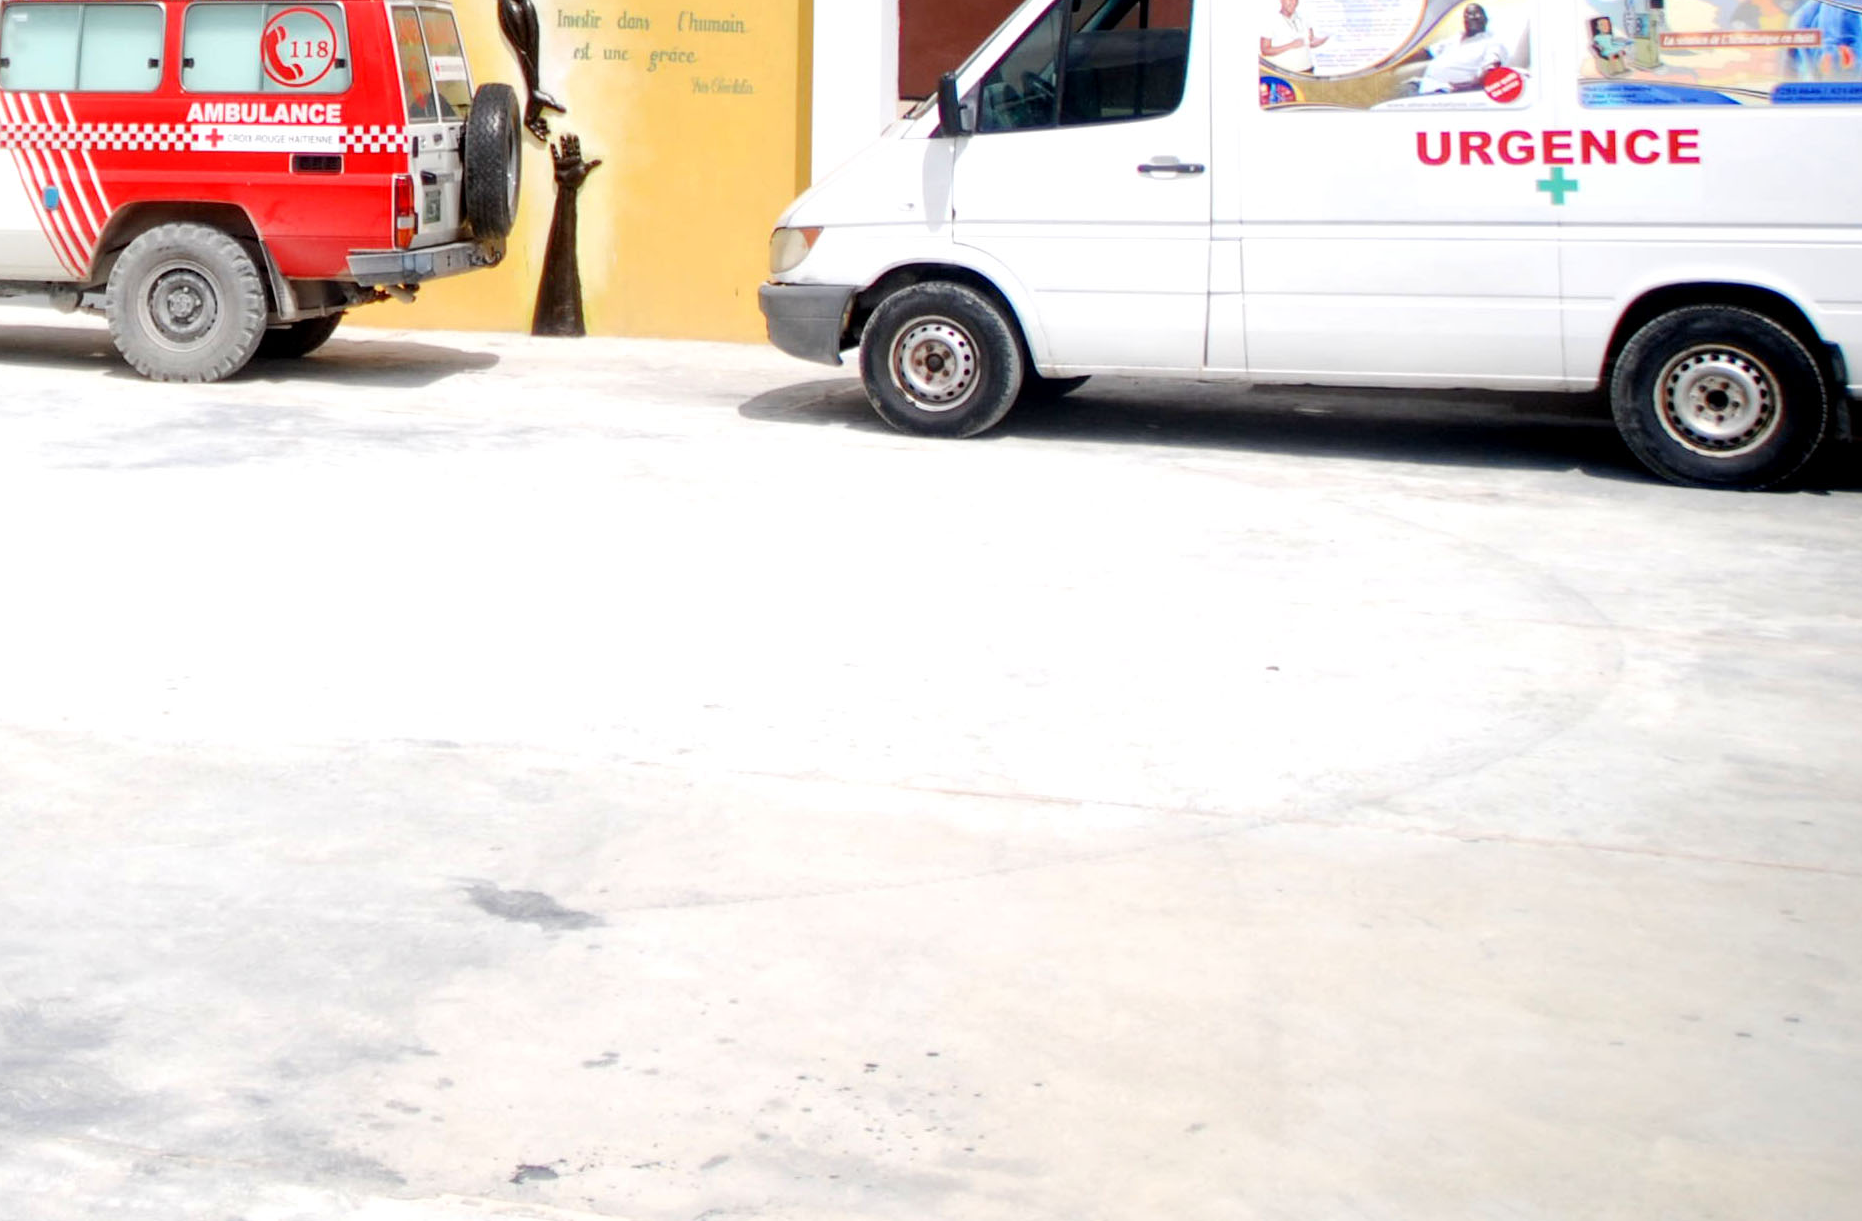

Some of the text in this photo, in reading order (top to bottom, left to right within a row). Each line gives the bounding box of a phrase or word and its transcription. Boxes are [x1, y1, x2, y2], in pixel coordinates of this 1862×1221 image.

[617, 11, 650, 30] dans
[290, 41, 329, 58] 118
[573, 42, 592, 60] est
[603, 47, 629, 60] une
[186, 102, 342, 124] AMBULANCE
[1416, 129, 1701, 166] URGENCE
